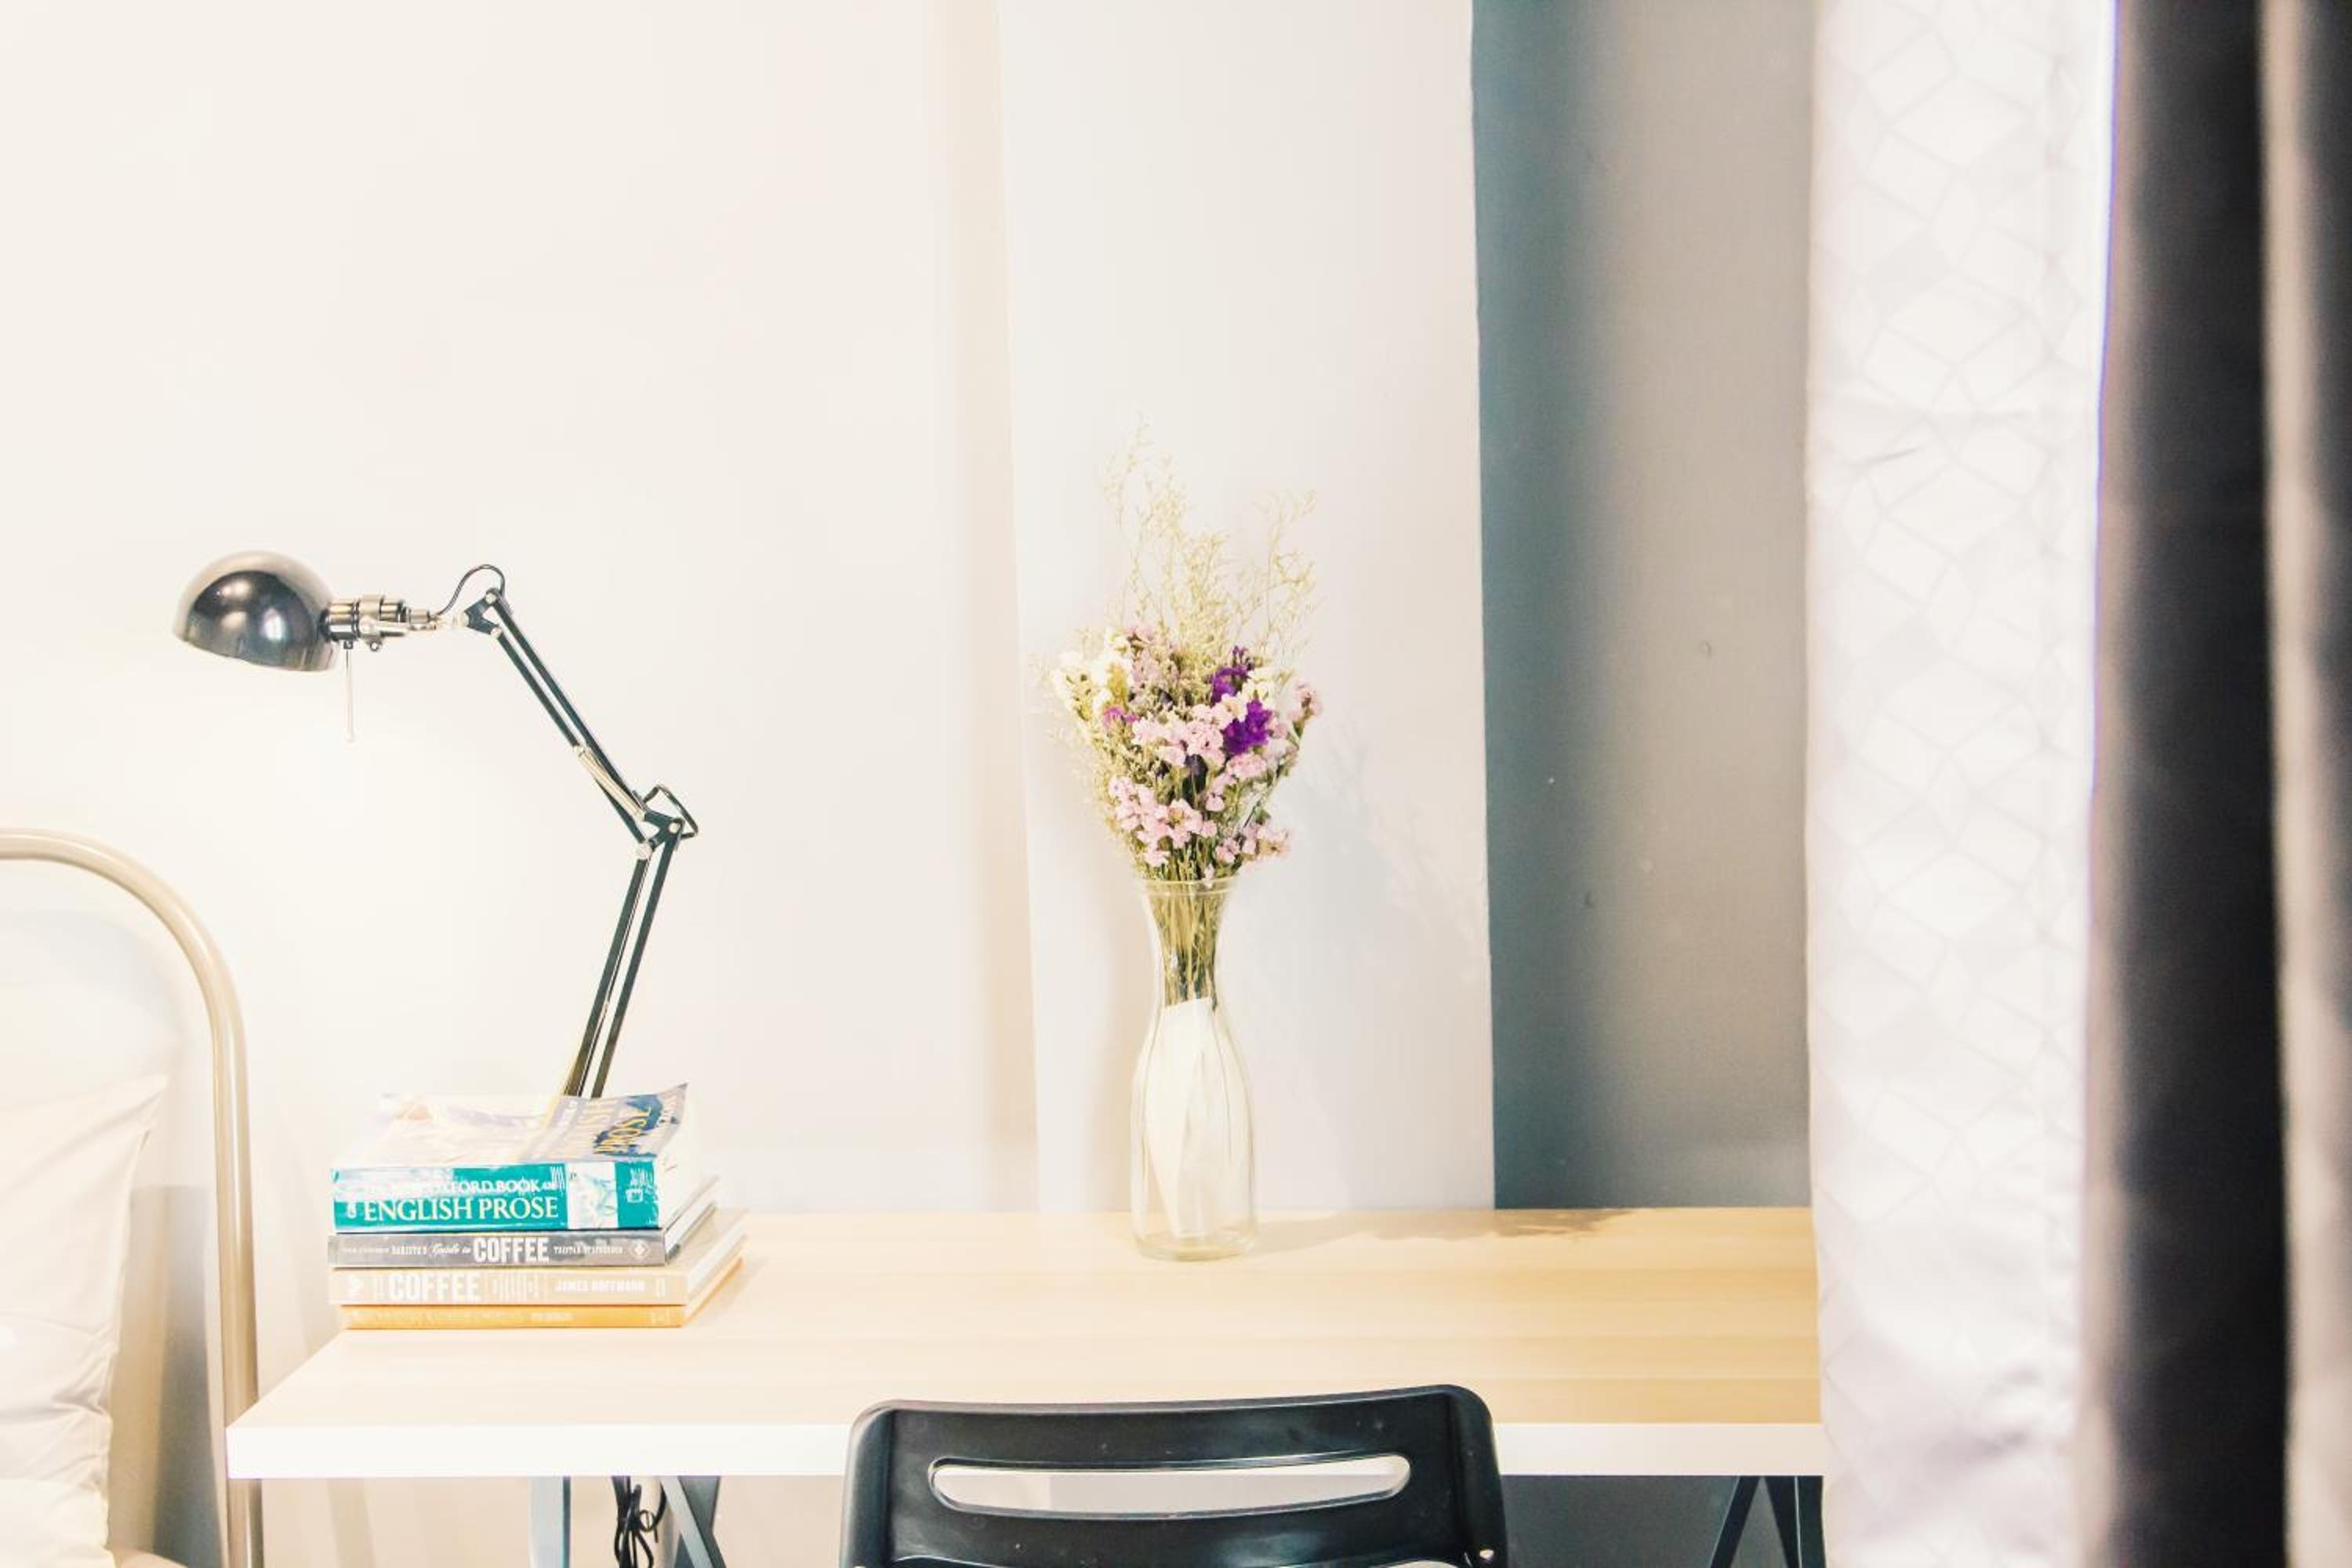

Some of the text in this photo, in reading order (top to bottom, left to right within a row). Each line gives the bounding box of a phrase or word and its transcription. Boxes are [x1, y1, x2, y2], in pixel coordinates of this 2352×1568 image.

[497, 1178, 541, 1192] BOOK
[363, 1196, 559, 1221] ENGLISH PROSE
[473, 1236, 550, 1263] COFFEE
[389, 1273, 483, 1301] COFFEE
